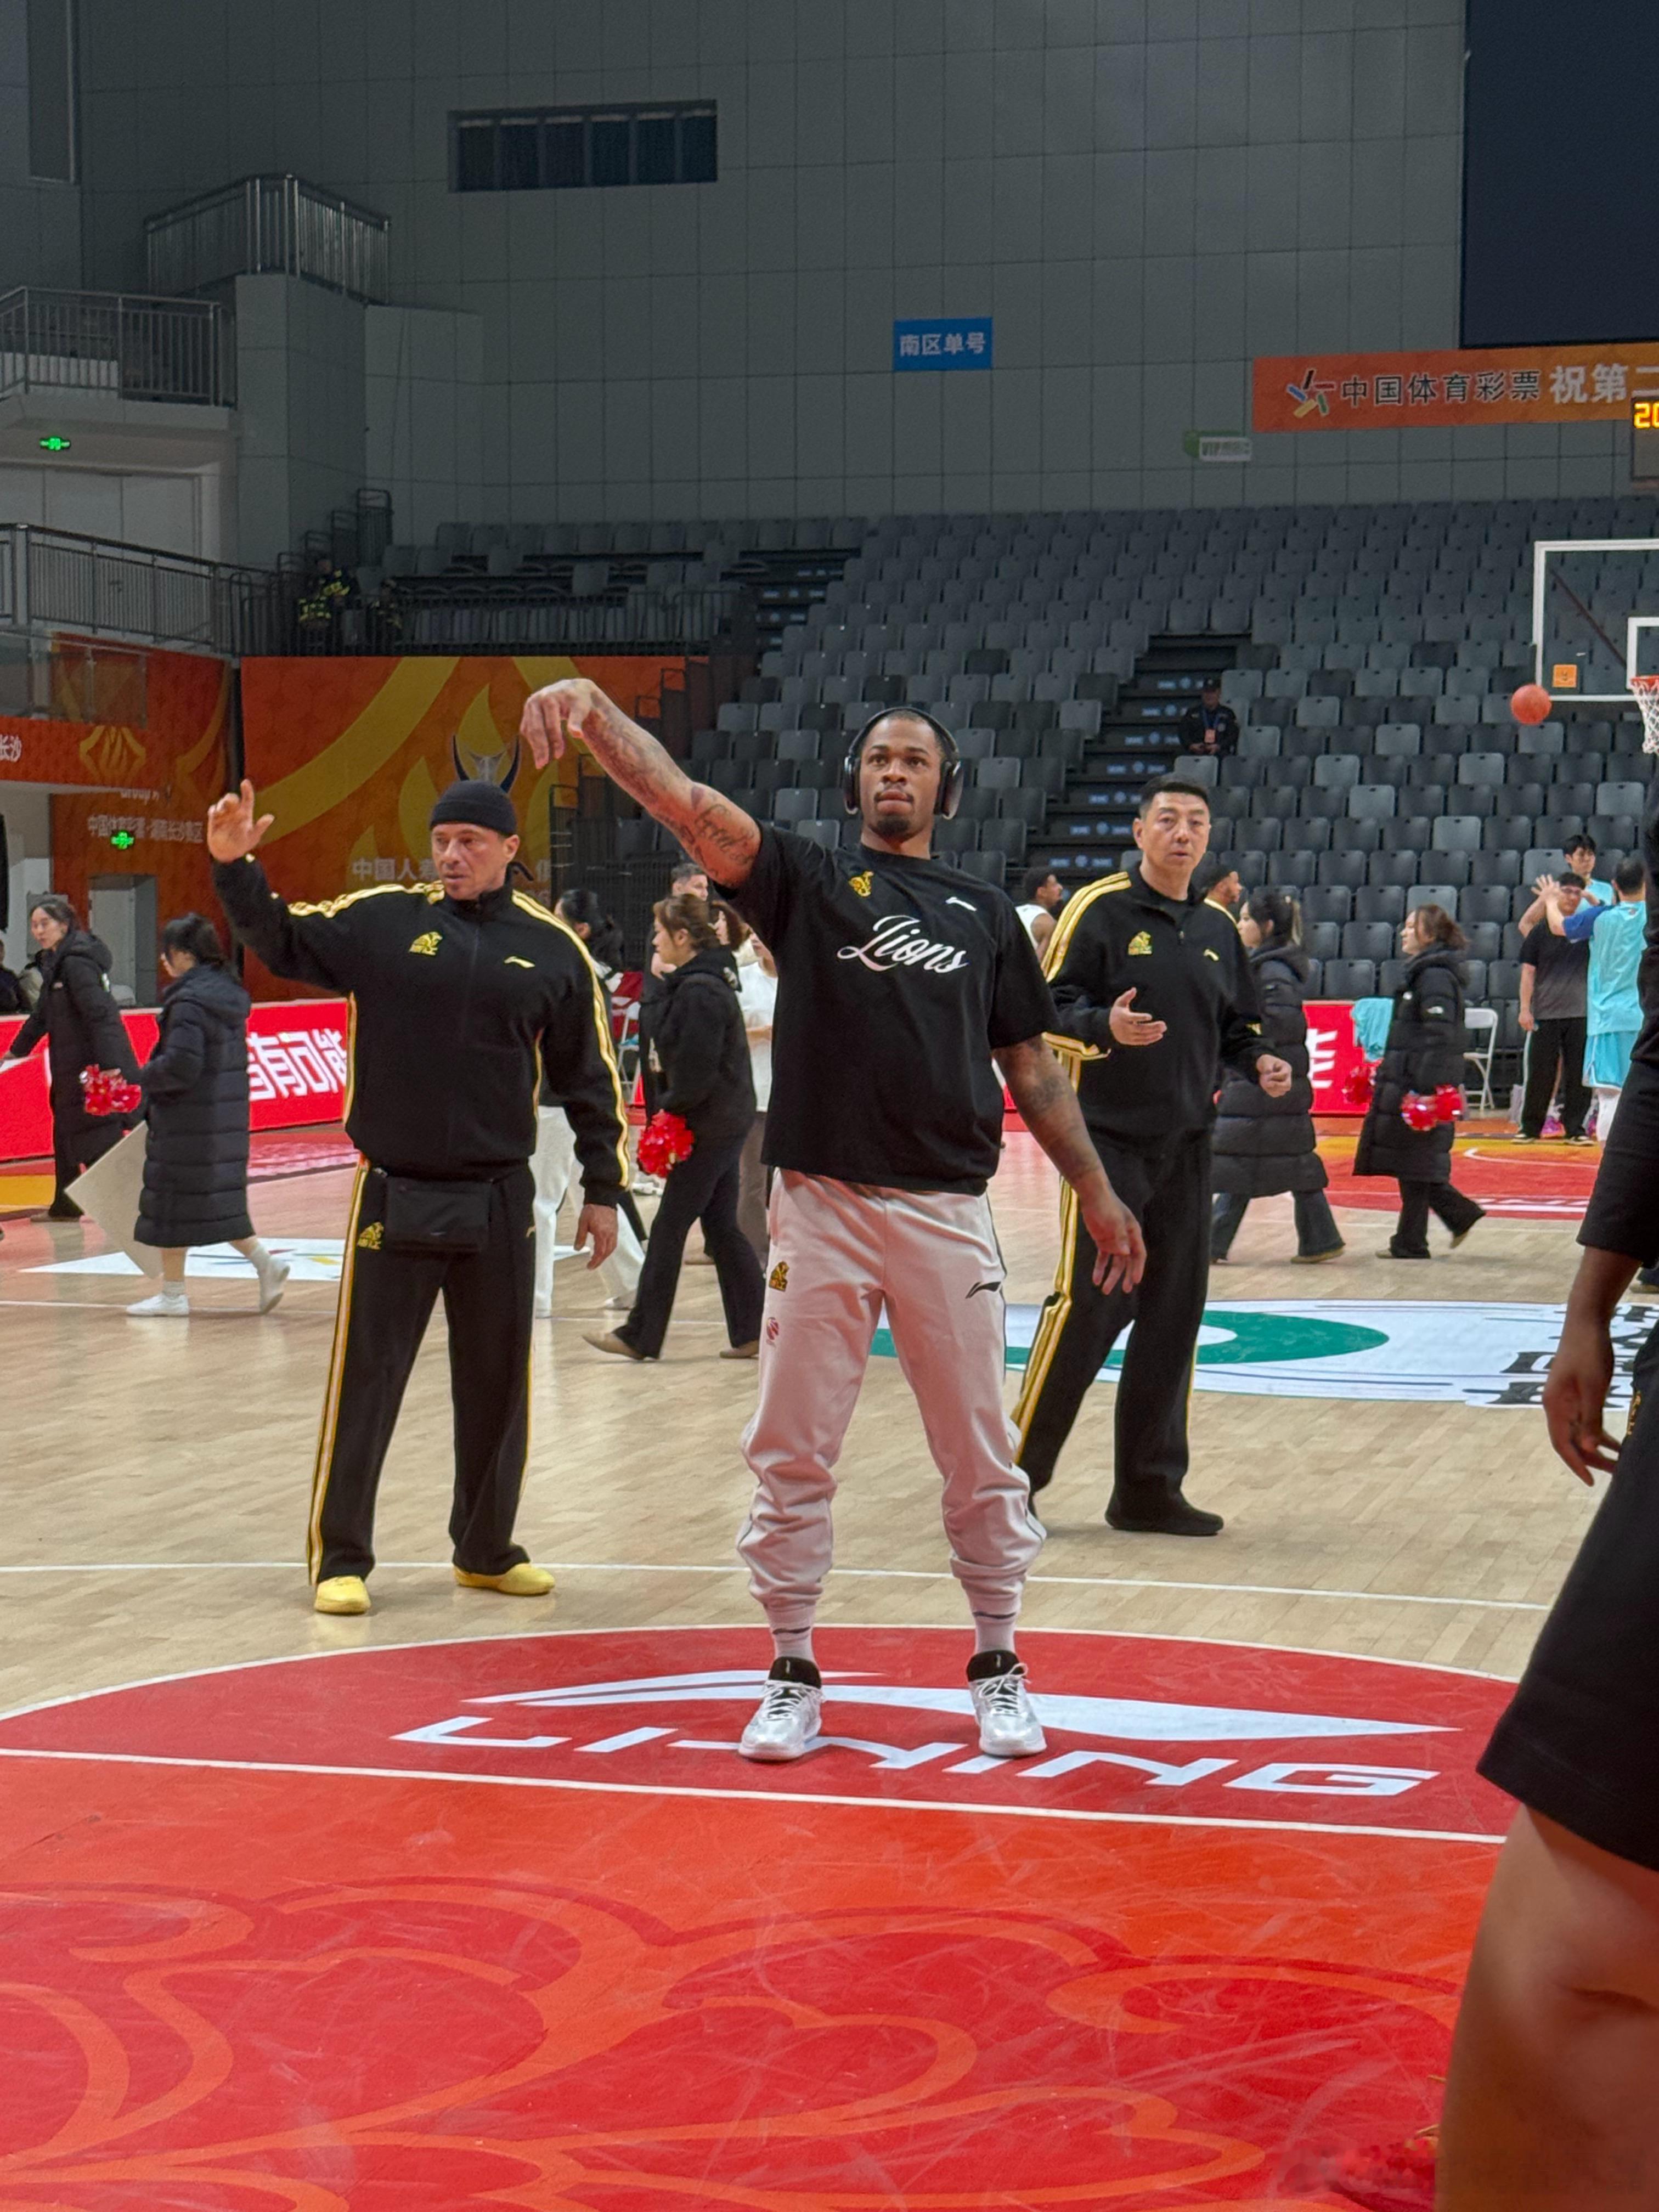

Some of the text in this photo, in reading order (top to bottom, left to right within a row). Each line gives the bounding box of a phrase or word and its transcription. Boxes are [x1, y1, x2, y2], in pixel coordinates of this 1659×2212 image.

[899, 332, 986, 357] 南区单号
[1341, 369, 1541, 408] 中国体育彩票
[837, 915, 970, 974] Lions
